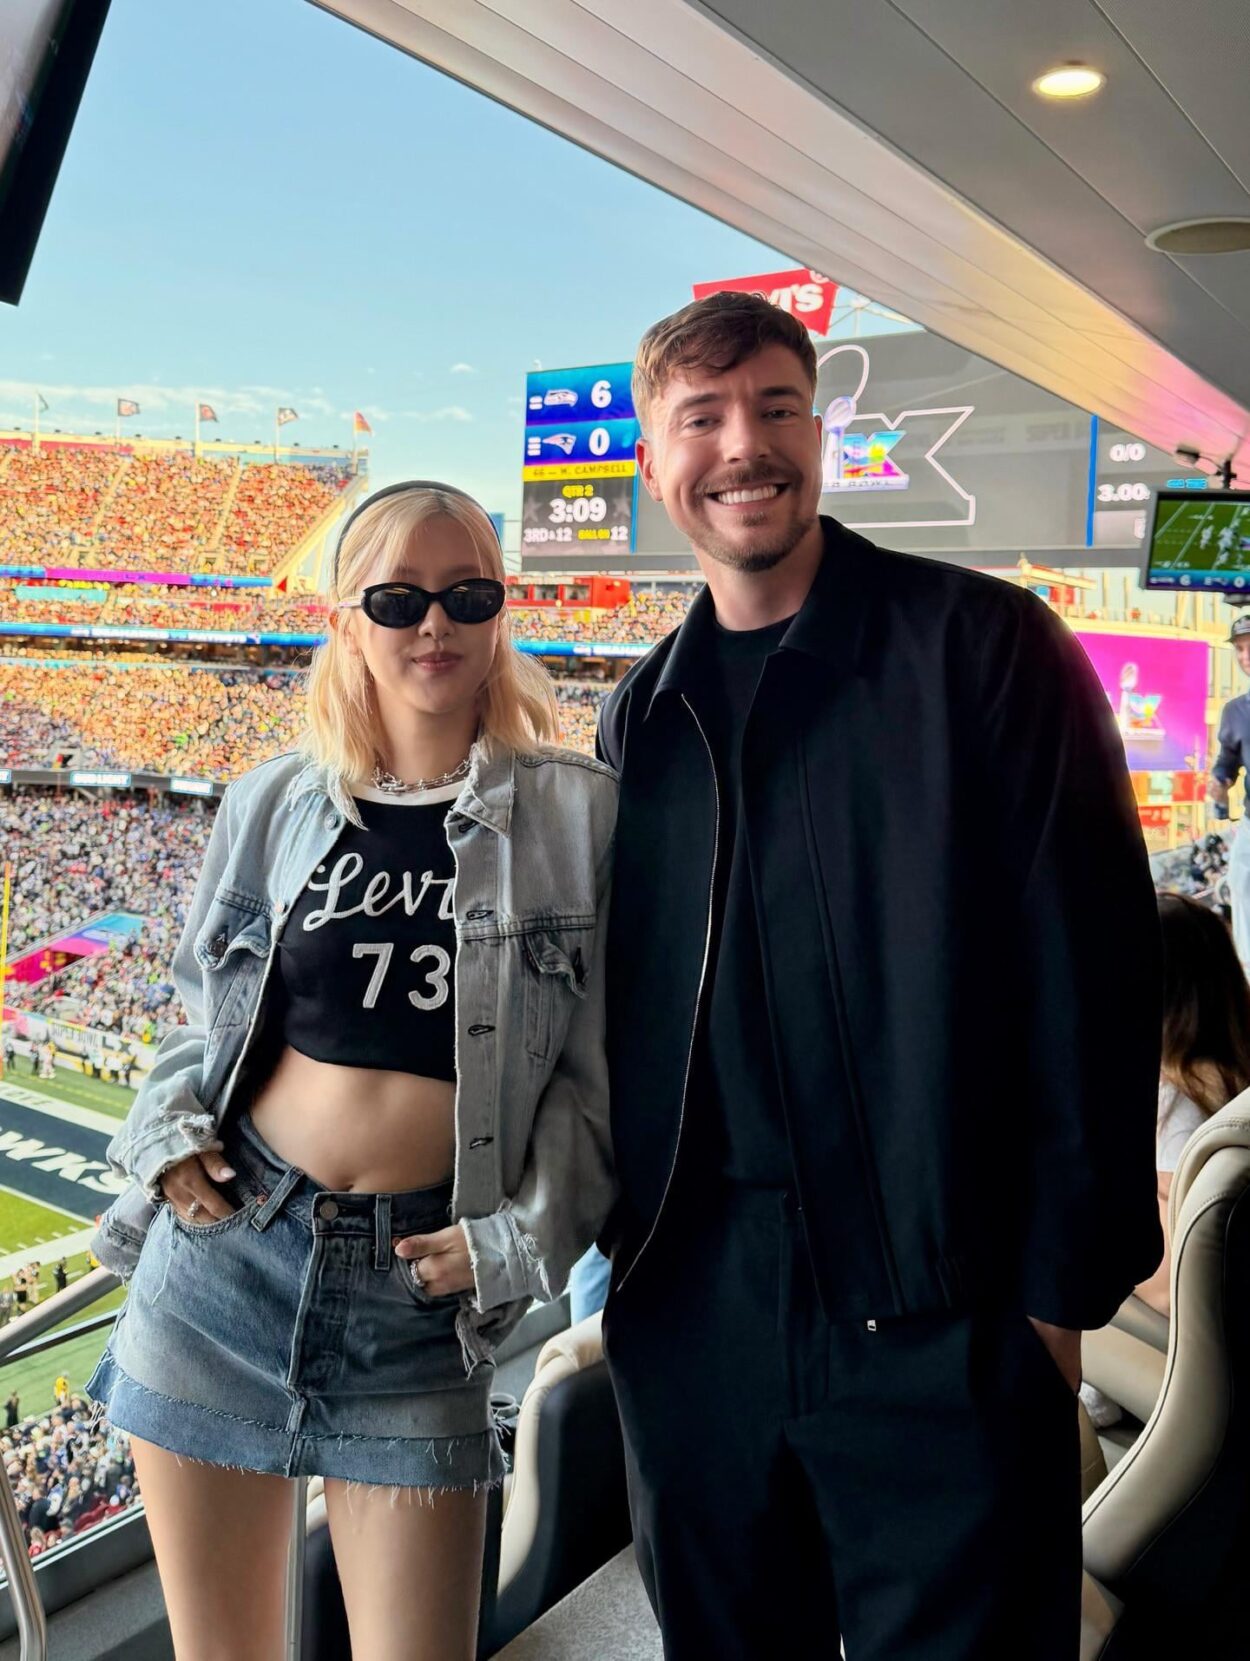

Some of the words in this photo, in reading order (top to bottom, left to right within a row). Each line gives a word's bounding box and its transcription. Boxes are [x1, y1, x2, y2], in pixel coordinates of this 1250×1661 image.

[591, 380, 612, 408] 6
[589, 427, 610, 456] 0
[548, 497, 607, 523] 3:09
[611, 525, 629, 541] 12
[352, 942, 450, 1011] 73
[0, 1127, 132, 1195] WKS
